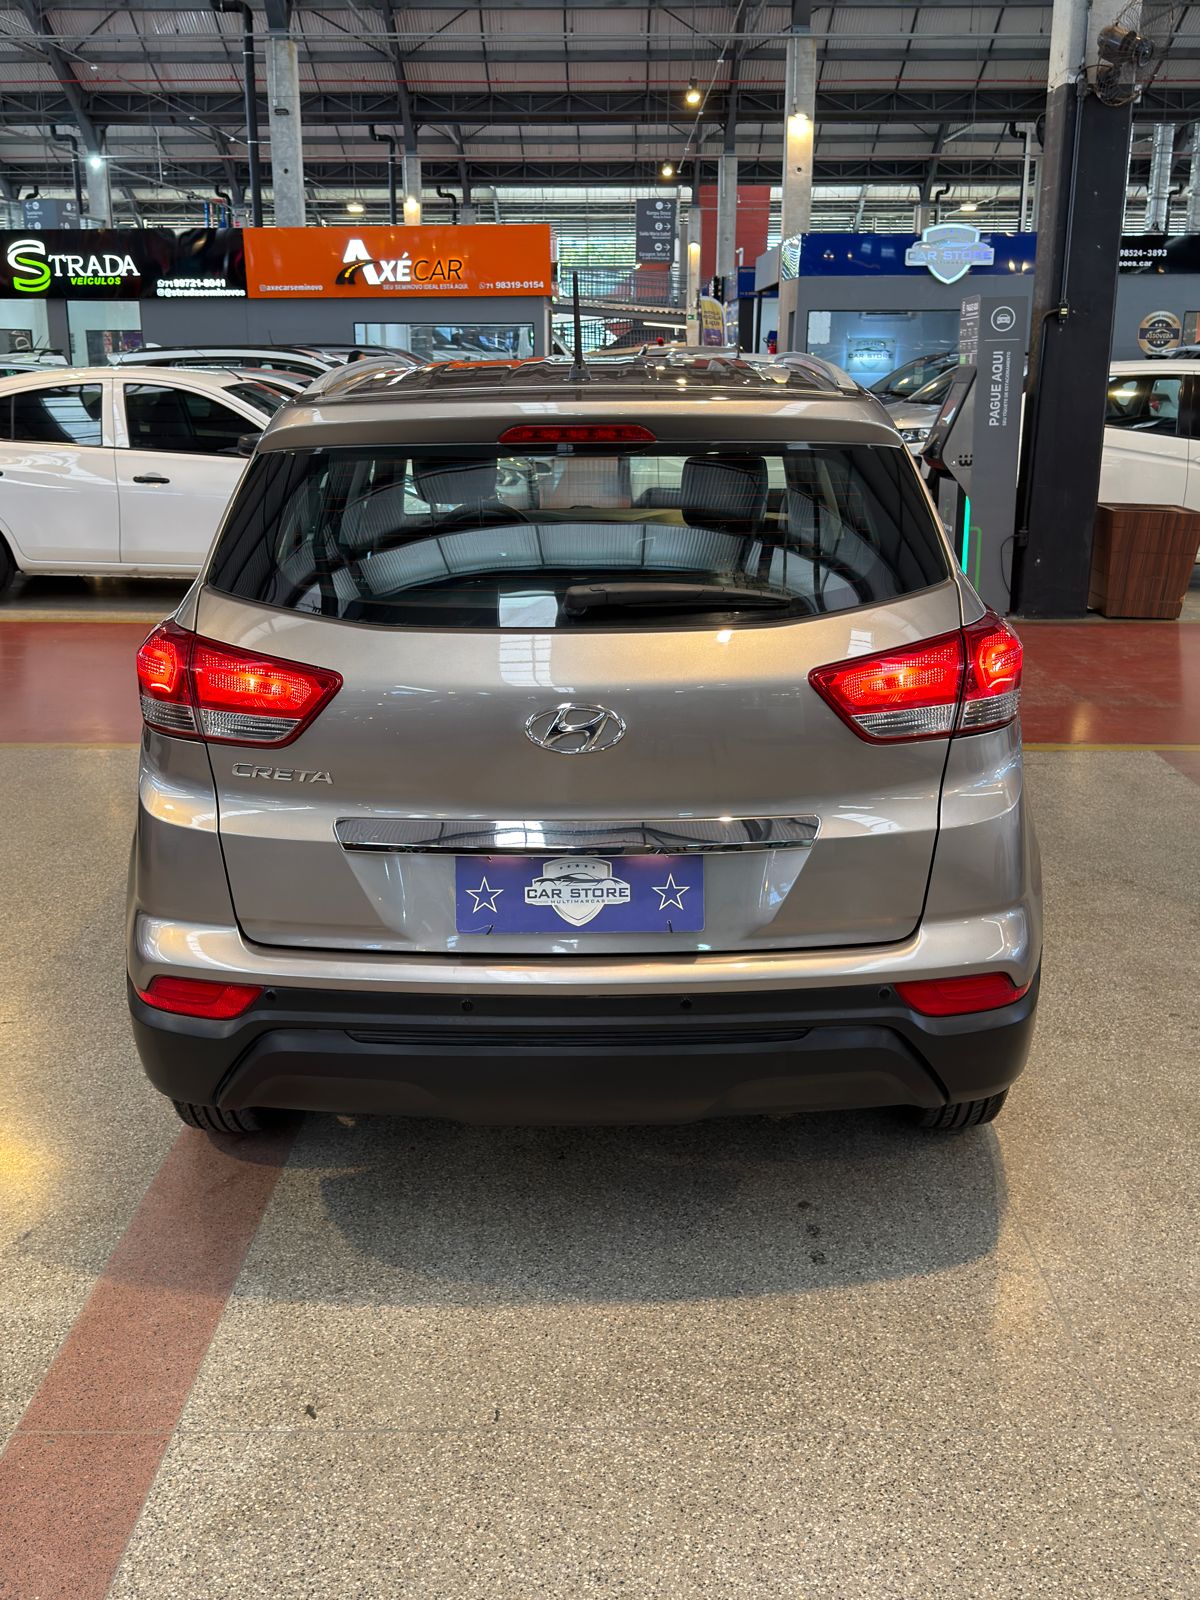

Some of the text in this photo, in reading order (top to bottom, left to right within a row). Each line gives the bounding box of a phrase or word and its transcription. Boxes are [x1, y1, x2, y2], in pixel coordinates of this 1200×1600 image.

[908, 250, 993, 260] CAR STORE
[7, 239, 141, 292] STRADA
[70, 276, 122, 286] VEÍCULOS
[495, 281, 544, 289] 98319-0154
[988, 350, 1004, 426] PAGUE AQUI
[231, 762, 334, 785] CRETA
[527, 887, 629, 899] CAR STORE
